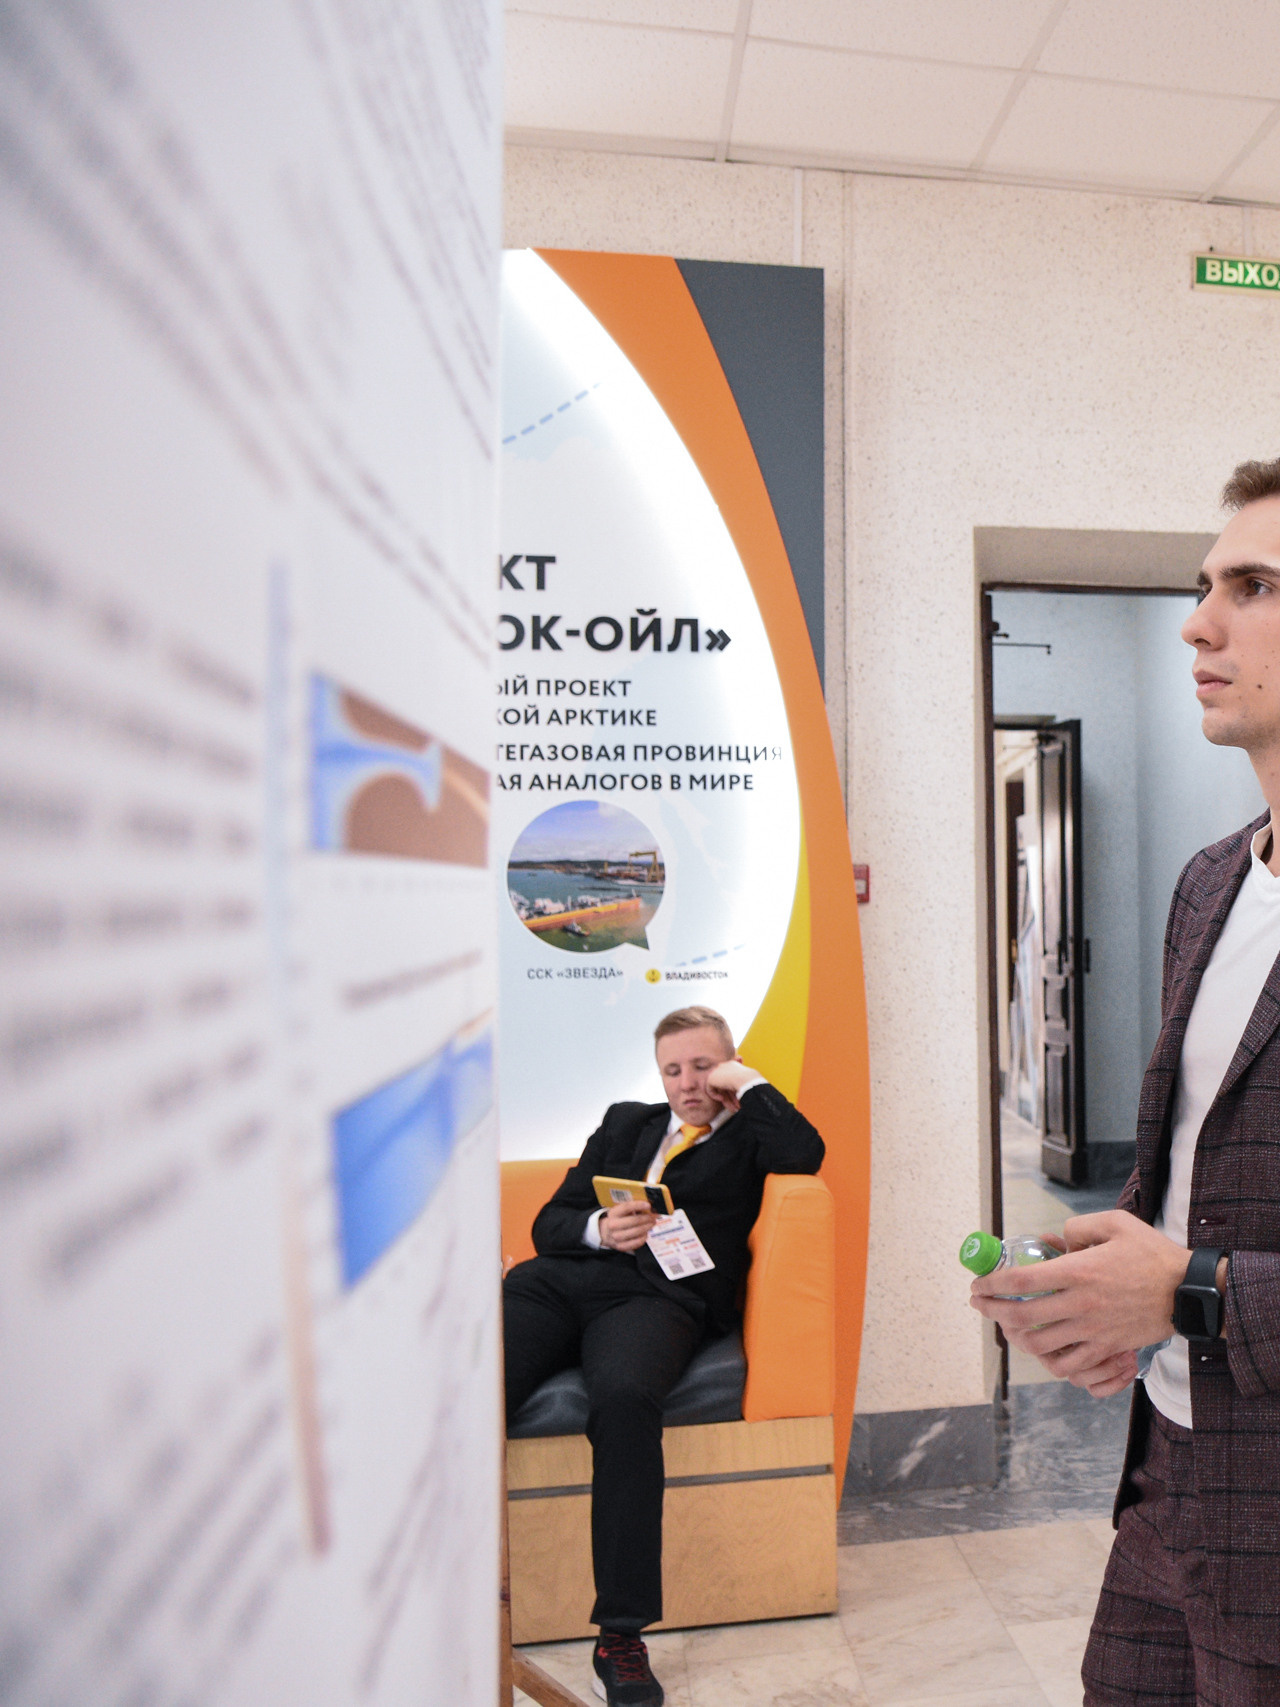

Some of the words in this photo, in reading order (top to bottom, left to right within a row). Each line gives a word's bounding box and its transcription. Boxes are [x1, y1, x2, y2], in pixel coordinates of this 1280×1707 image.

[537, 679, 631, 696] ПРОЕКТ
[547, 709, 657, 726] АРКТИКЕ
[634, 745, 781, 763] ПРОВИНЦИЯ
[529, 774, 662, 791] АНАЛОГОВ
[670, 774, 681, 790] В
[689, 774, 753, 790] МИРЕ
[527, 968, 551, 980] ССК
[556, 967, 623, 981] «ЗВЕЗДА»
[665, 971, 728, 981] ВЛАДИВОСТОК
